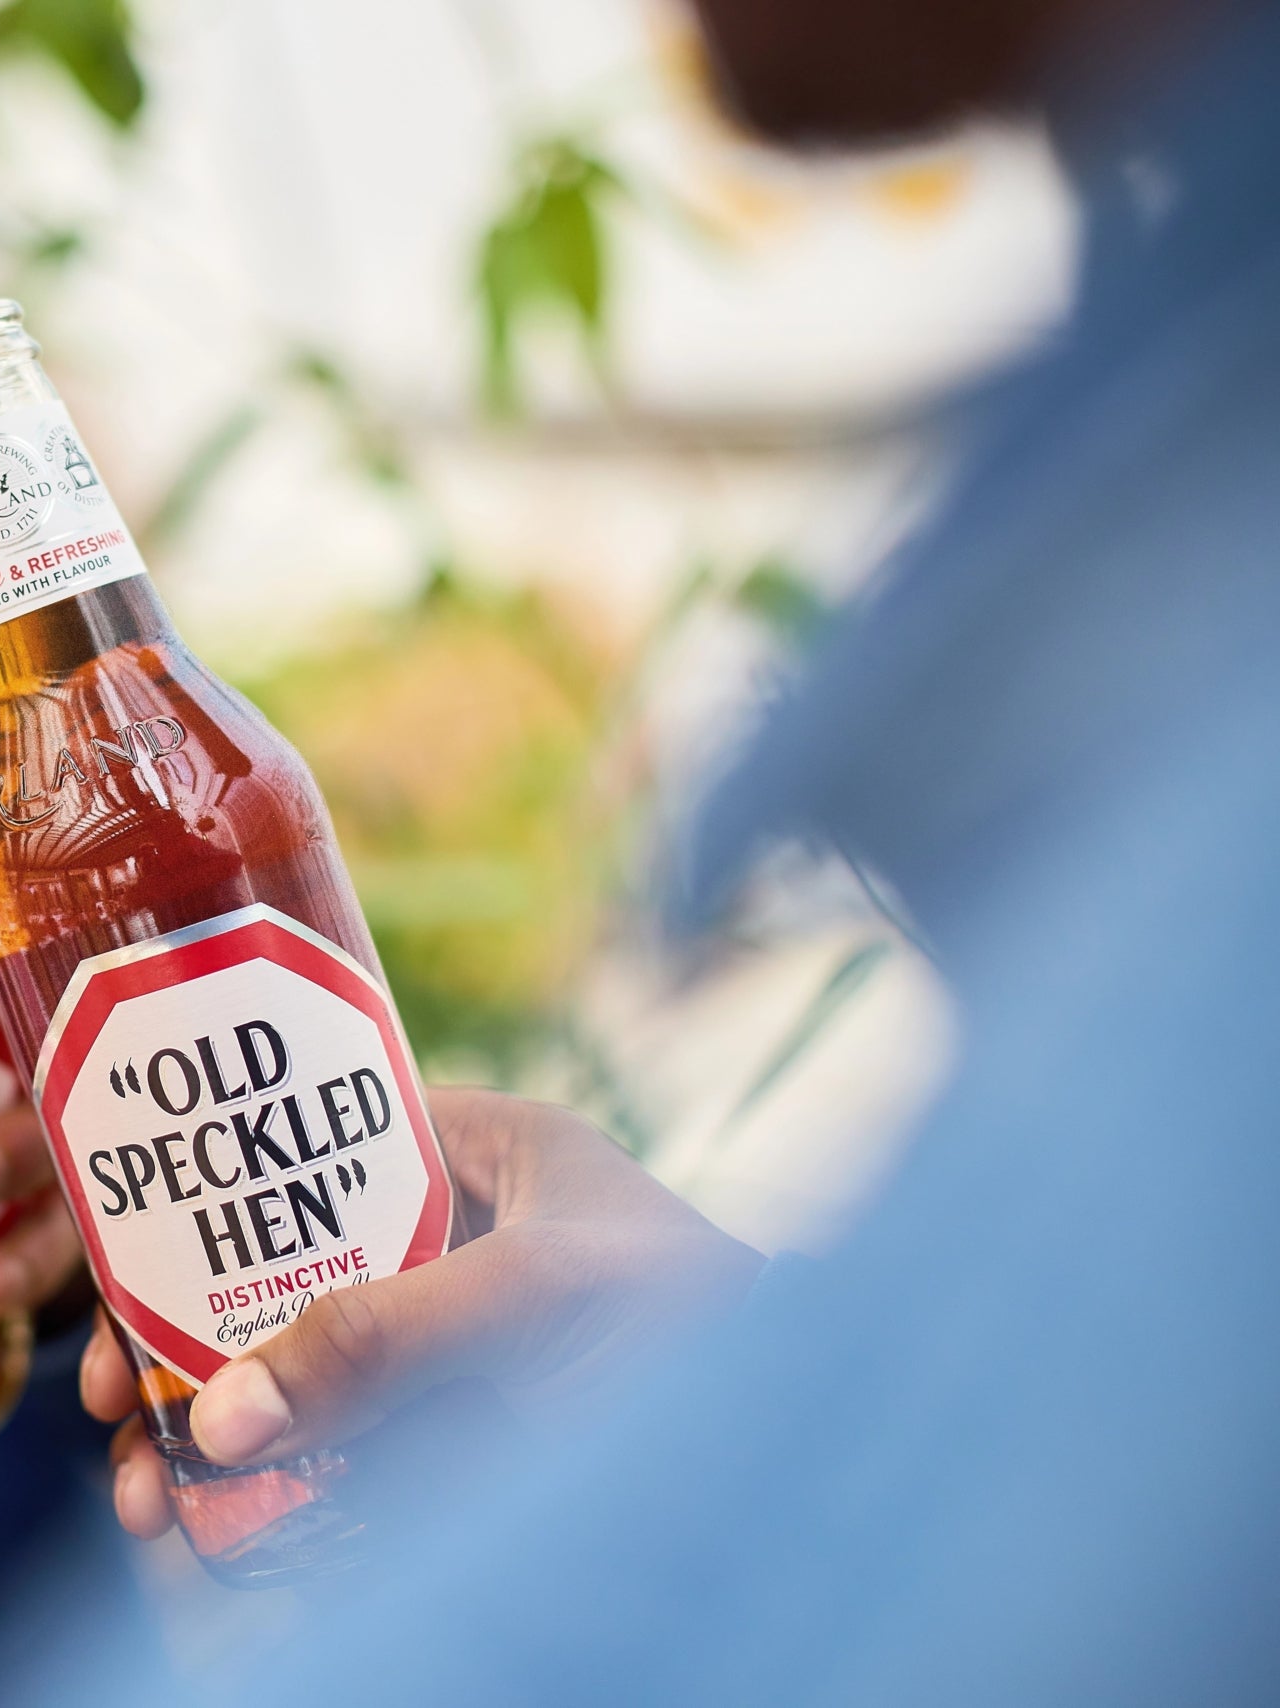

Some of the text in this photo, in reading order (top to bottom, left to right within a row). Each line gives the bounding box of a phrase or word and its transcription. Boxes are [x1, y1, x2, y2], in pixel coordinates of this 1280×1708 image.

[57, 481, 72, 495] OF
[16, 508, 38, 531] 1711
[9, 564, 25, 581] &
[27, 529, 126, 574] REFRESHING
[12, 575, 51, 599] WITH
[53, 555, 112, 584] FLAVOUR
[88, 1067, 393, 1216] SPECKLED
[207, 1246, 369, 1315] DISTINCTIVE
[217, 1301, 291, 1347] English
